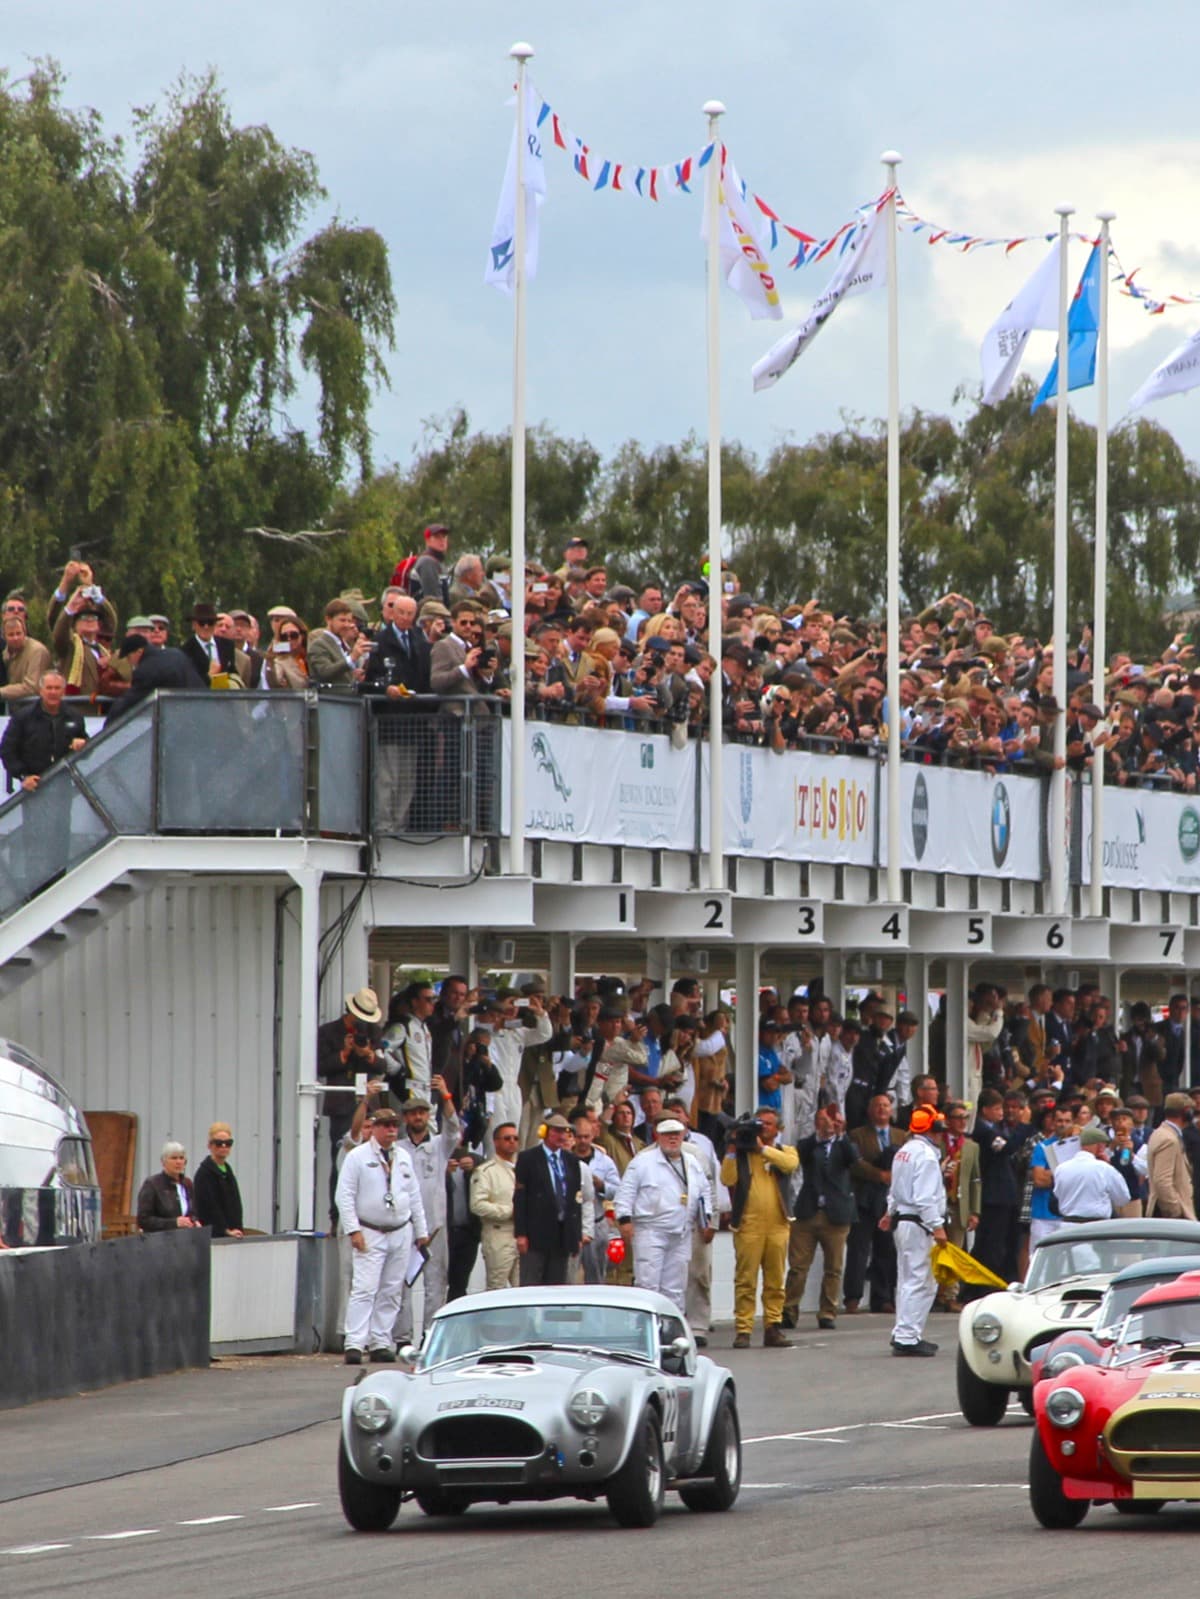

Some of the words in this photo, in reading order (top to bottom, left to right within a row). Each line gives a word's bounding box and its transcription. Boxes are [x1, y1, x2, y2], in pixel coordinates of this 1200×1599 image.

[525, 810, 575, 833] JAGUAR
[619, 893, 626, 922] 1
[704, 900, 724, 928] 2
[798, 907, 816, 934] 3
[882, 913, 901, 940] 4
[967, 918, 985, 944] 5
[1046, 923, 1064, 949] 6
[1159, 931, 1176, 956] 7
[1061, 1302, 1101, 1319] 17
